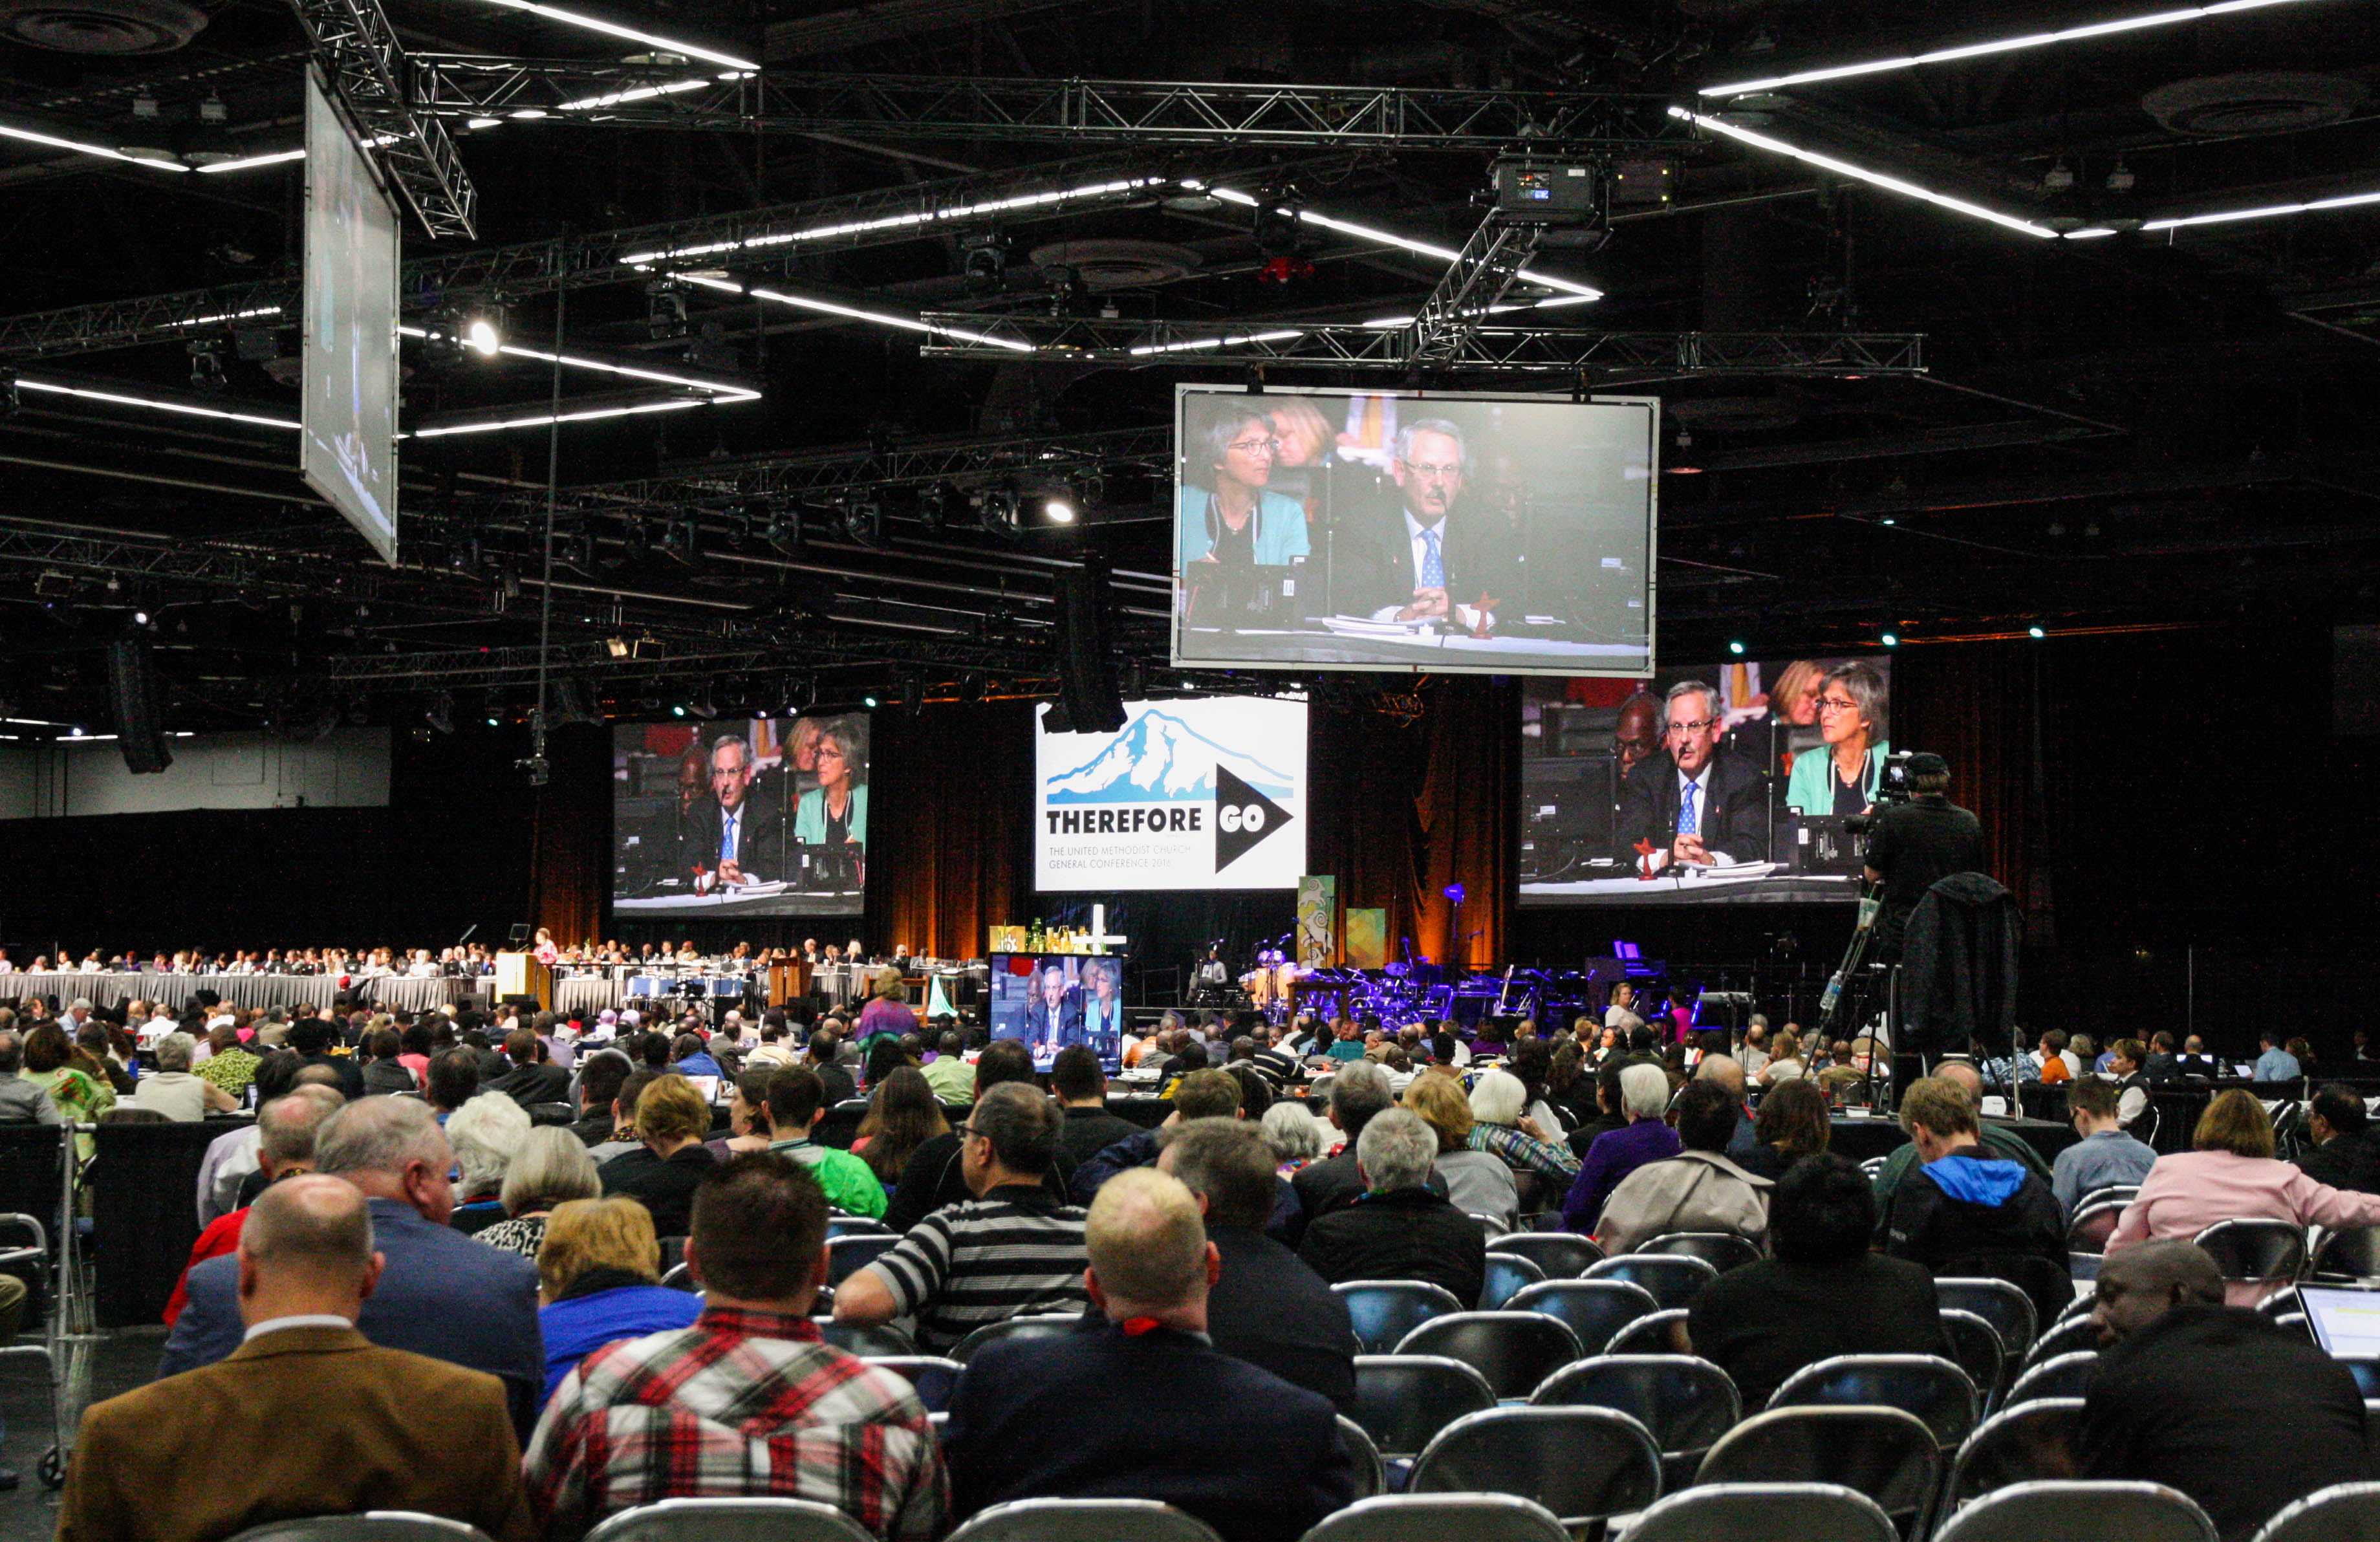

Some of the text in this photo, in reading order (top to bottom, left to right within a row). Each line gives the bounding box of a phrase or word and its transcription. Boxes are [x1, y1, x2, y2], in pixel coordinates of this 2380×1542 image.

[1046, 804, 1264, 834] THEREFORE GO
[1049, 845, 1191, 856] THE UNITED METHODIST CHURCH
[1048, 859, 1087, 869] GENERAL
[1090, 858, 1148, 868] CONFERENCE
